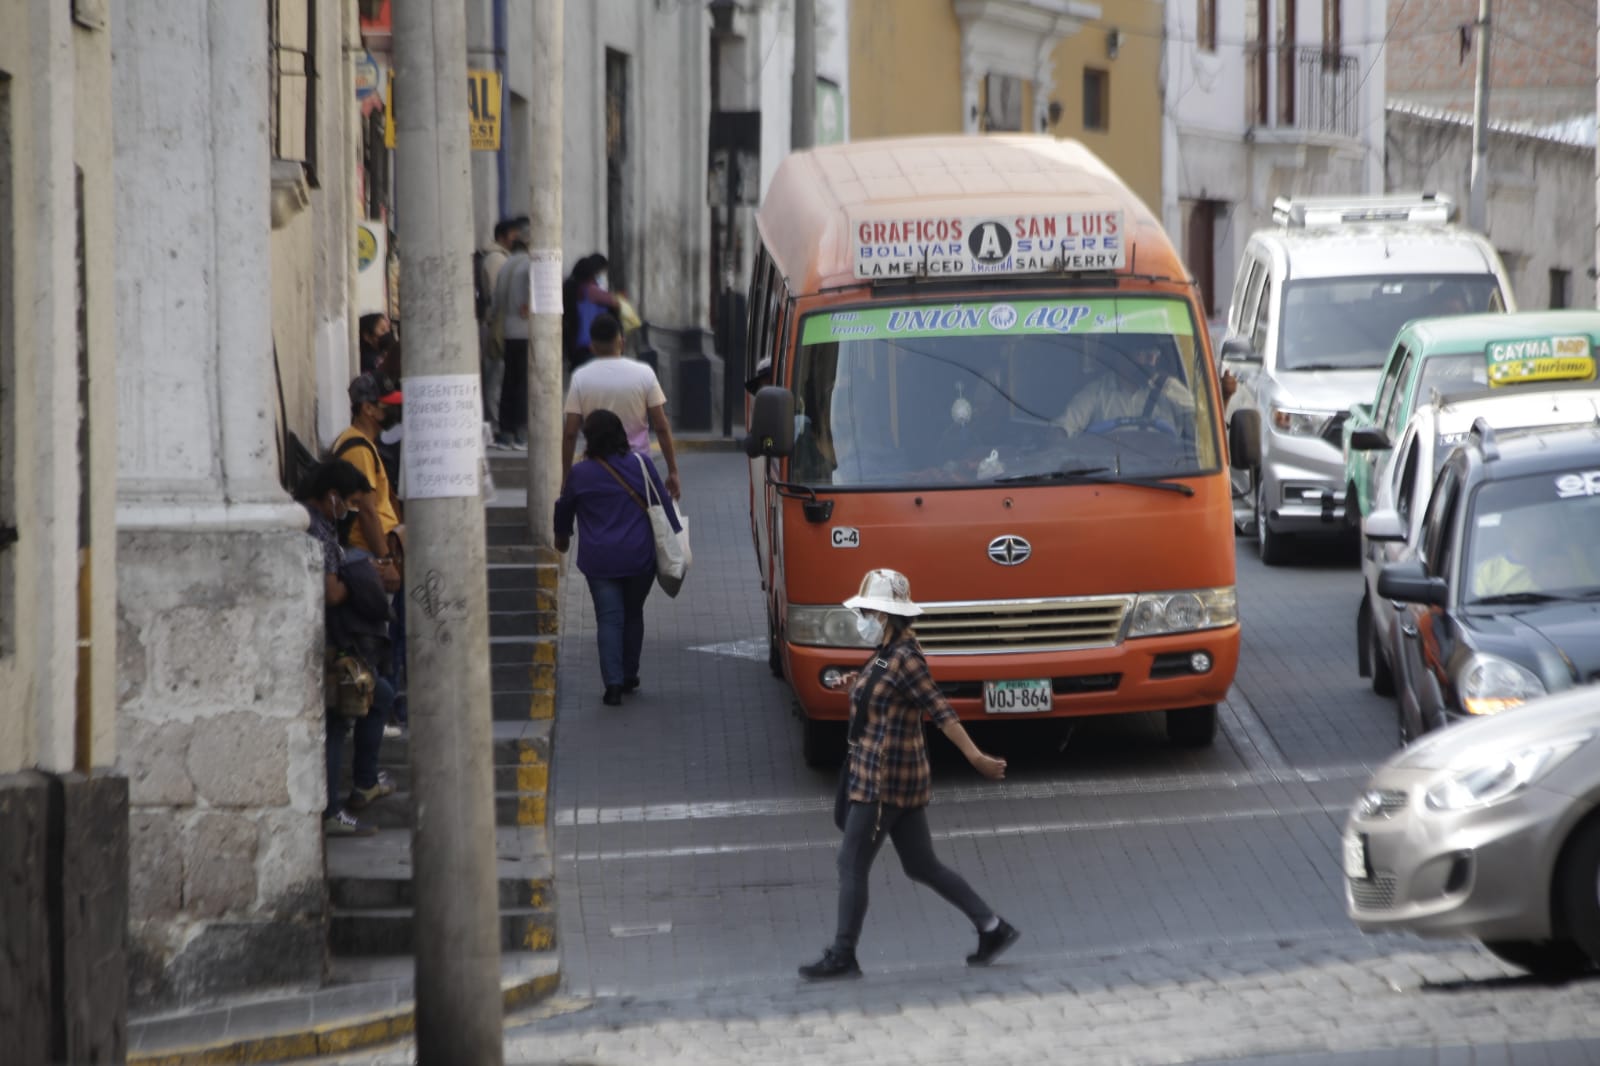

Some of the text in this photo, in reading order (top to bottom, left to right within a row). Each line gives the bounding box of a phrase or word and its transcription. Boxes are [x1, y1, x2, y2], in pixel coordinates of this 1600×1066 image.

[858, 217, 963, 245] GRAFICOS
[1015, 213, 1118, 239] SAN LUIS
[860, 244, 962, 259] BOLIVAR
[977, 223, 1004, 259] A
[1017, 236, 1120, 252] SUCRE
[1016, 252, 1119, 270] SALAVERRY
[887, 303, 984, 333] UNIÓN
[1023, 303, 1092, 333] AQP
[1492, 340, 1552, 361] CAYMA
[833, 530, 858, 545] C-4
